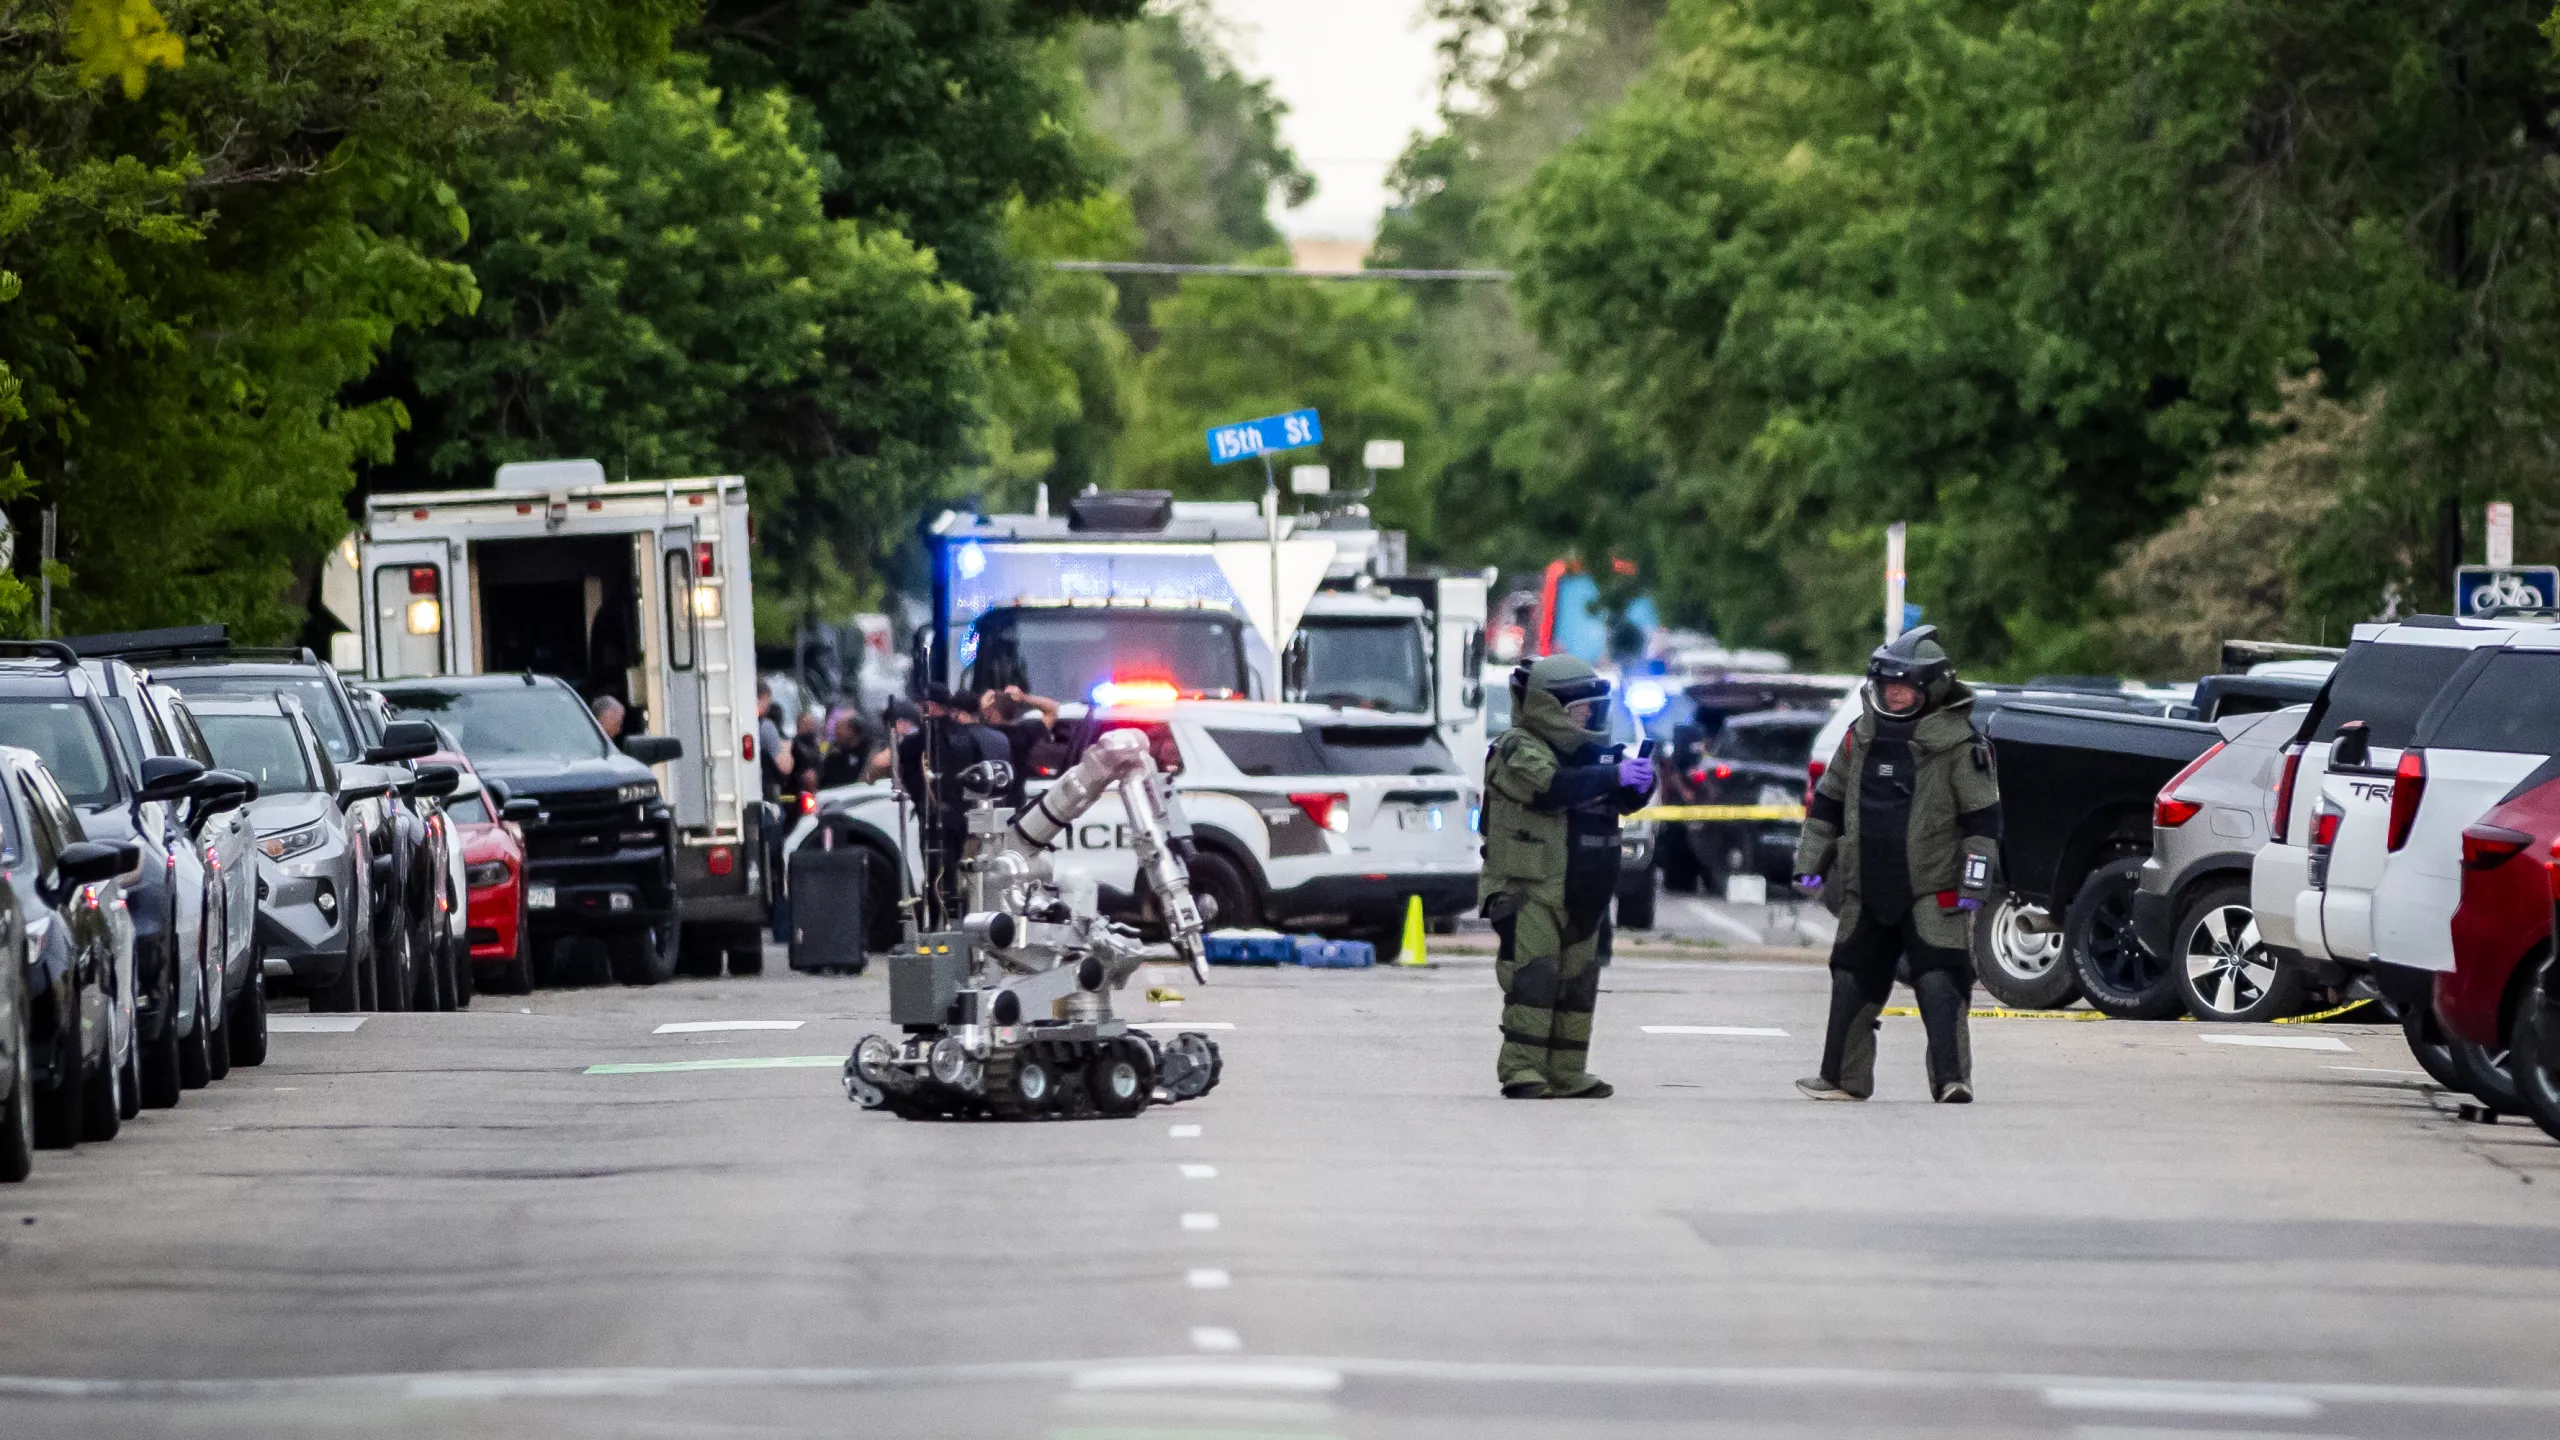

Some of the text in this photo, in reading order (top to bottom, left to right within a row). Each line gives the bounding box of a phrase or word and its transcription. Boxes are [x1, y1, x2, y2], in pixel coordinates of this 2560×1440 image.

[1216, 415, 1312, 458] 15th St
[2349, 782, 2395, 803] TR
[1063, 823, 1133, 850] ICE
